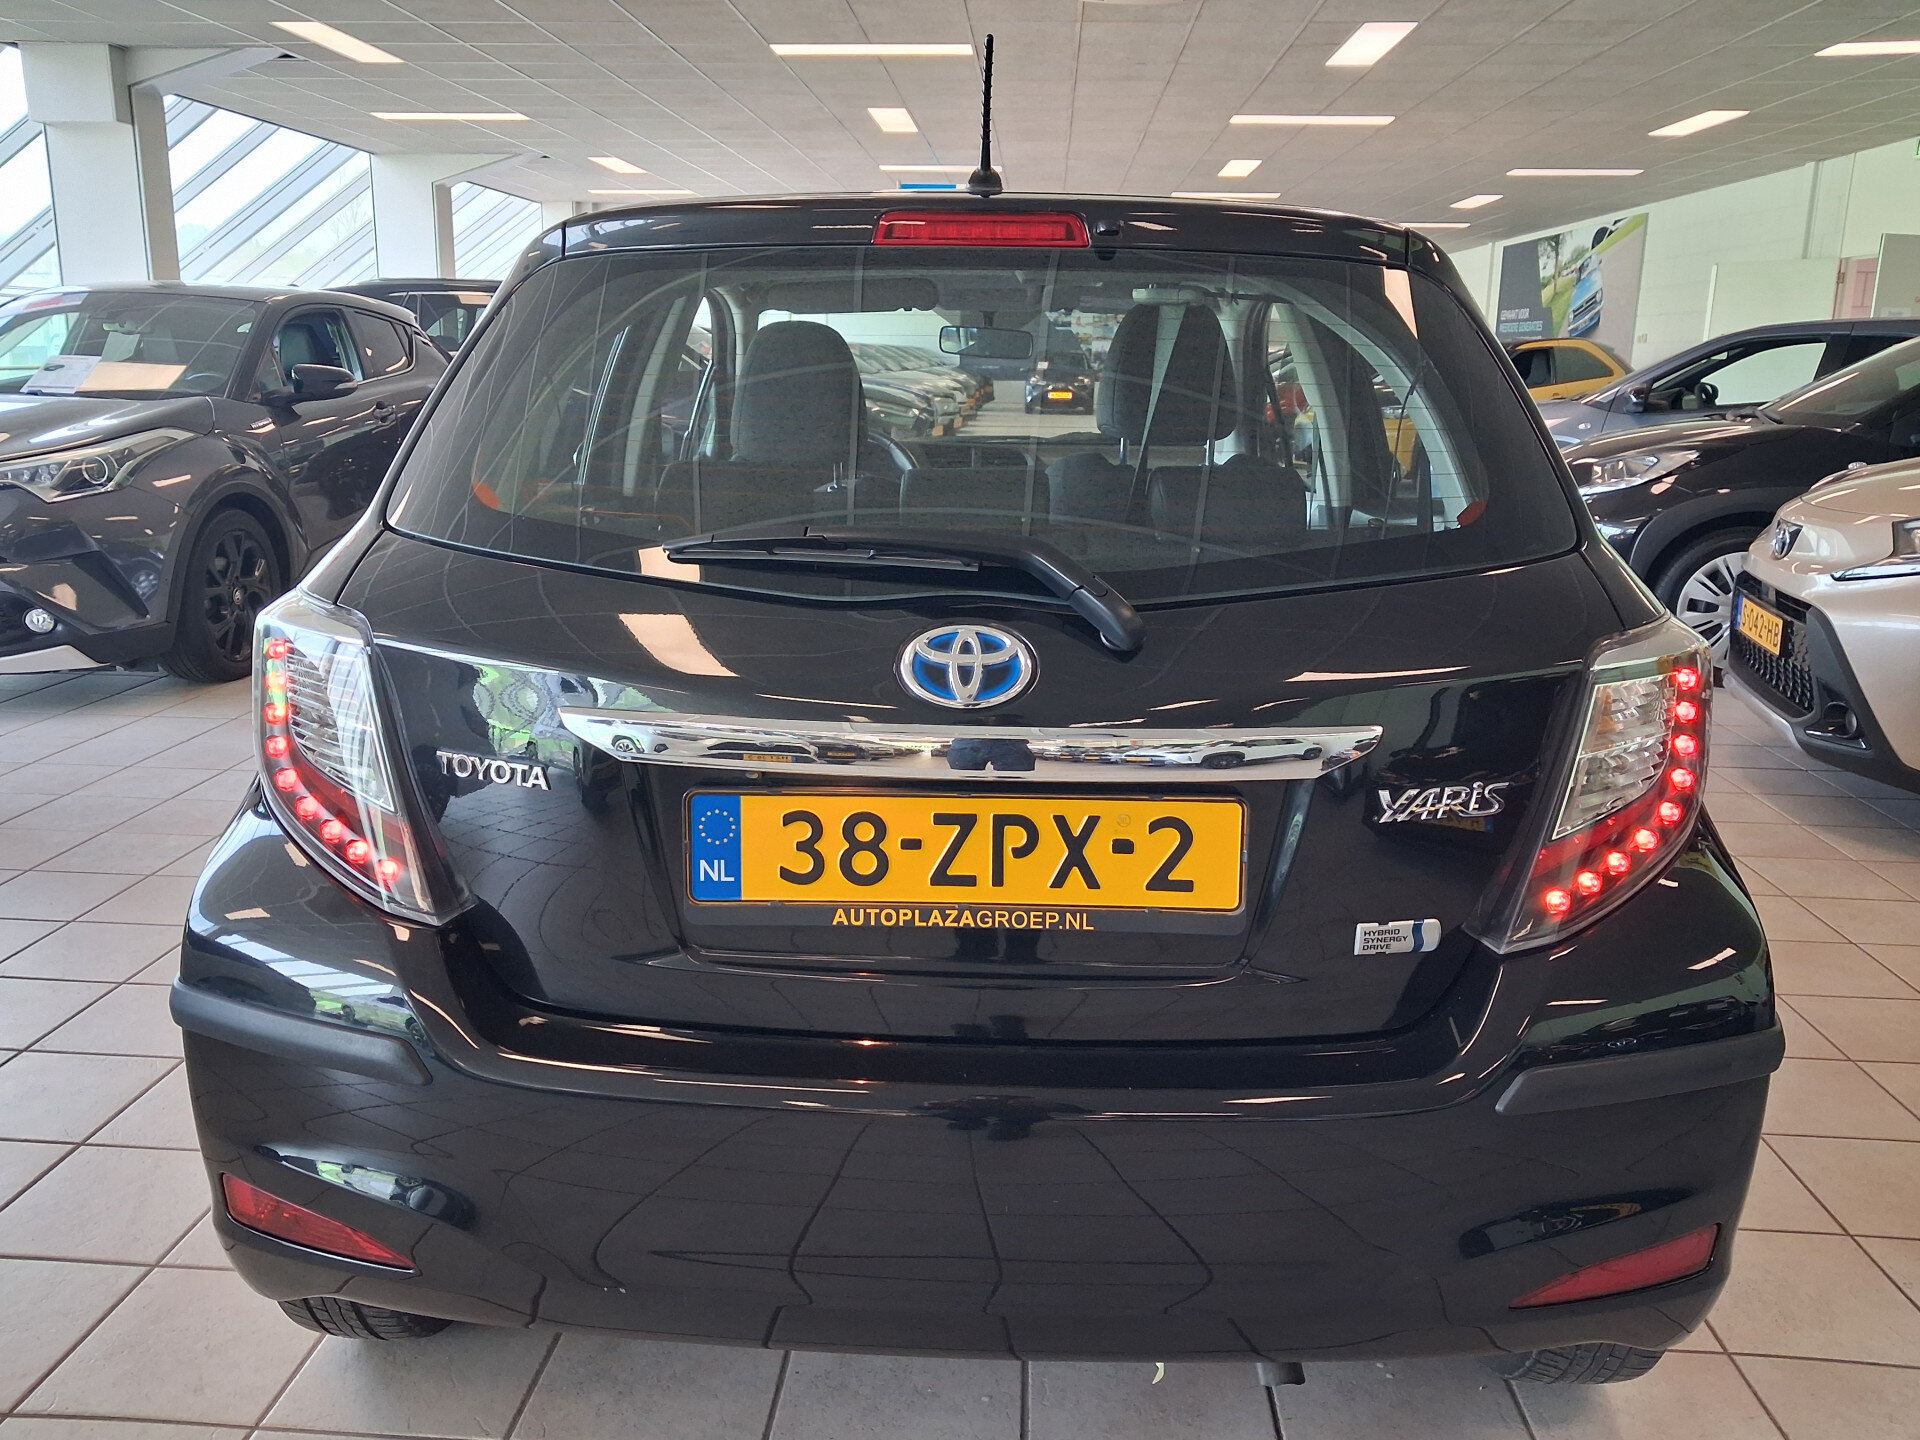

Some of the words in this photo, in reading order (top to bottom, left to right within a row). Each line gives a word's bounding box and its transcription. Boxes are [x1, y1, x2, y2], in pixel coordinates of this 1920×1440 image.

[436, 750, 551, 791] TOYOTA
[778, 809, 1196, 893] 38-ZPX-2
[699, 859, 736, 882] NL
[832, 908, 1095, 931] AUTOPLAZAGROEP.NL
[1363, 928, 1400, 937] HYBRID
[1363, 935, 1409, 944] SYNERGY
[1362, 943, 1391, 951] DRIVE
